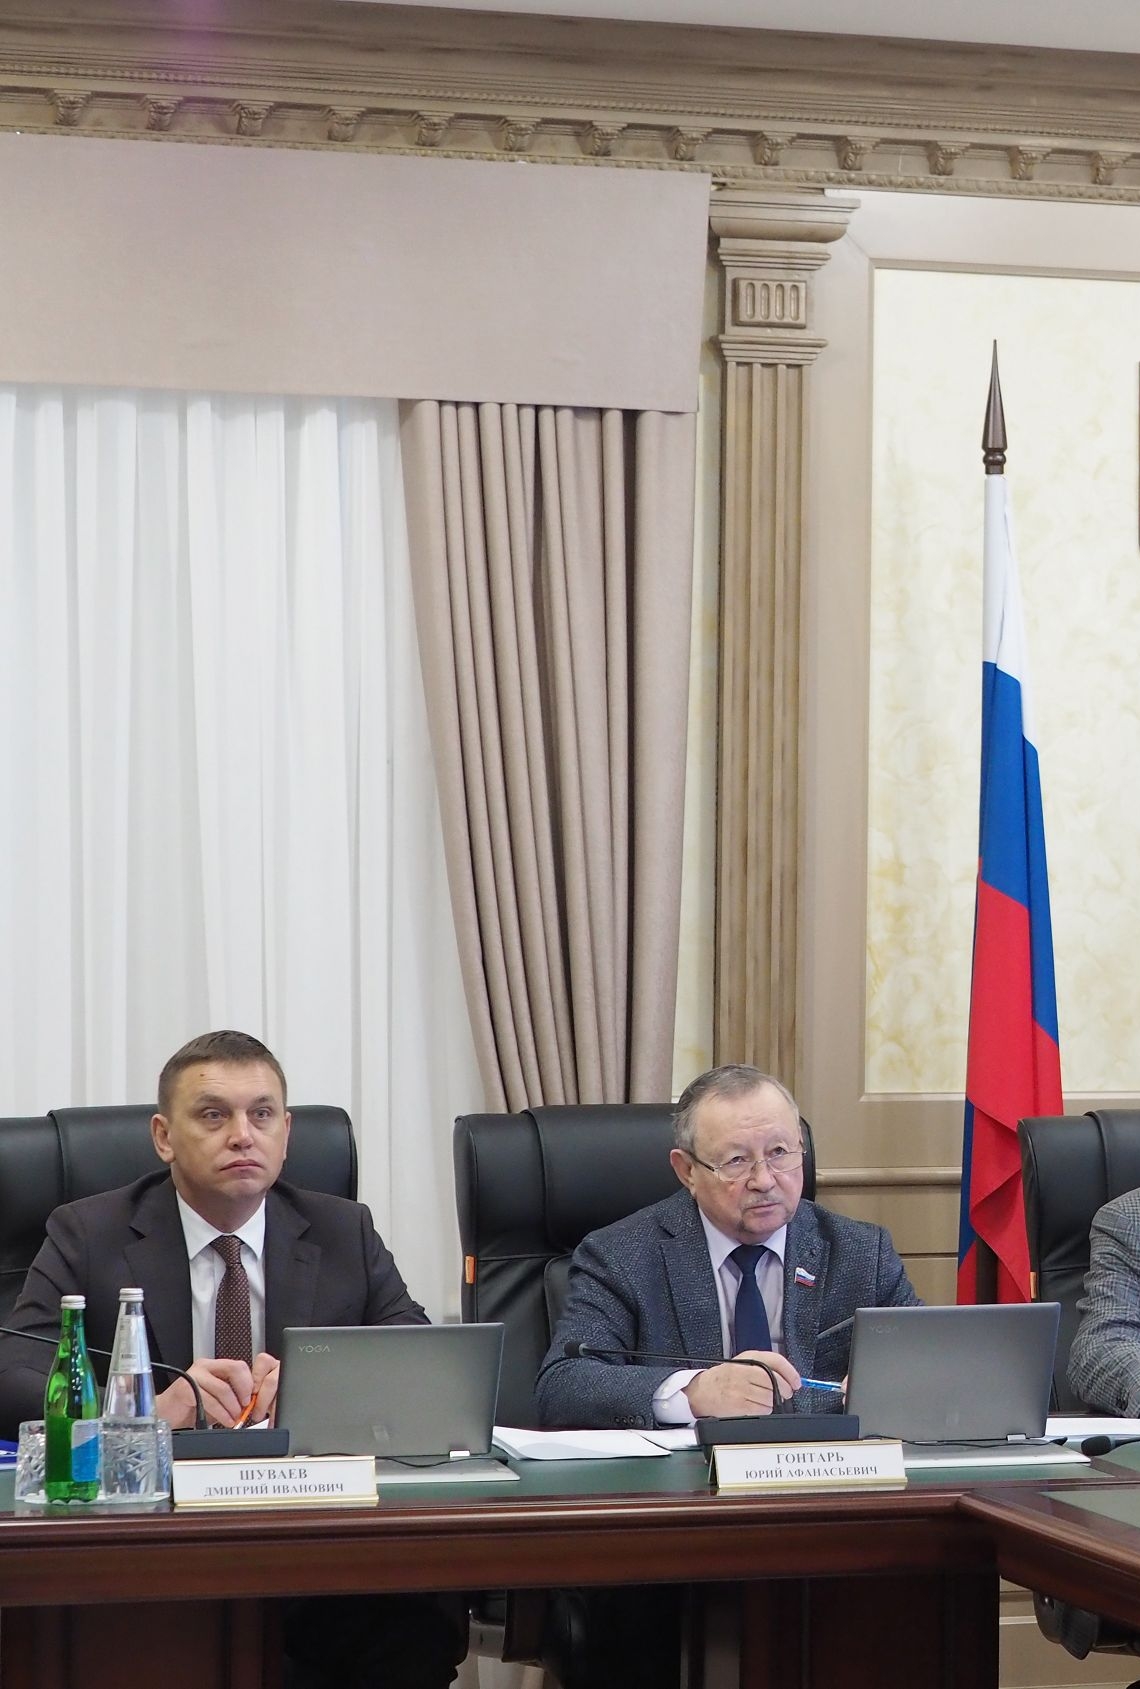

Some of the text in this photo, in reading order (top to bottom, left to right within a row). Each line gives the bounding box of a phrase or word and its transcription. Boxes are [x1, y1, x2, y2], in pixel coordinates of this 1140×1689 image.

[297, 1344, 331, 1353] YOGA
[776, 1451, 844, 1464] ГОНТАРЬ
[240, 1468, 308, 1481] ШУВАЕВ
[744, 1465, 878, 1480] ЮРИЙ АФАНАСЬЕВИЧ
[203, 1482, 344, 1498] ДМИТРИЙ ИВАНОВИЧ
